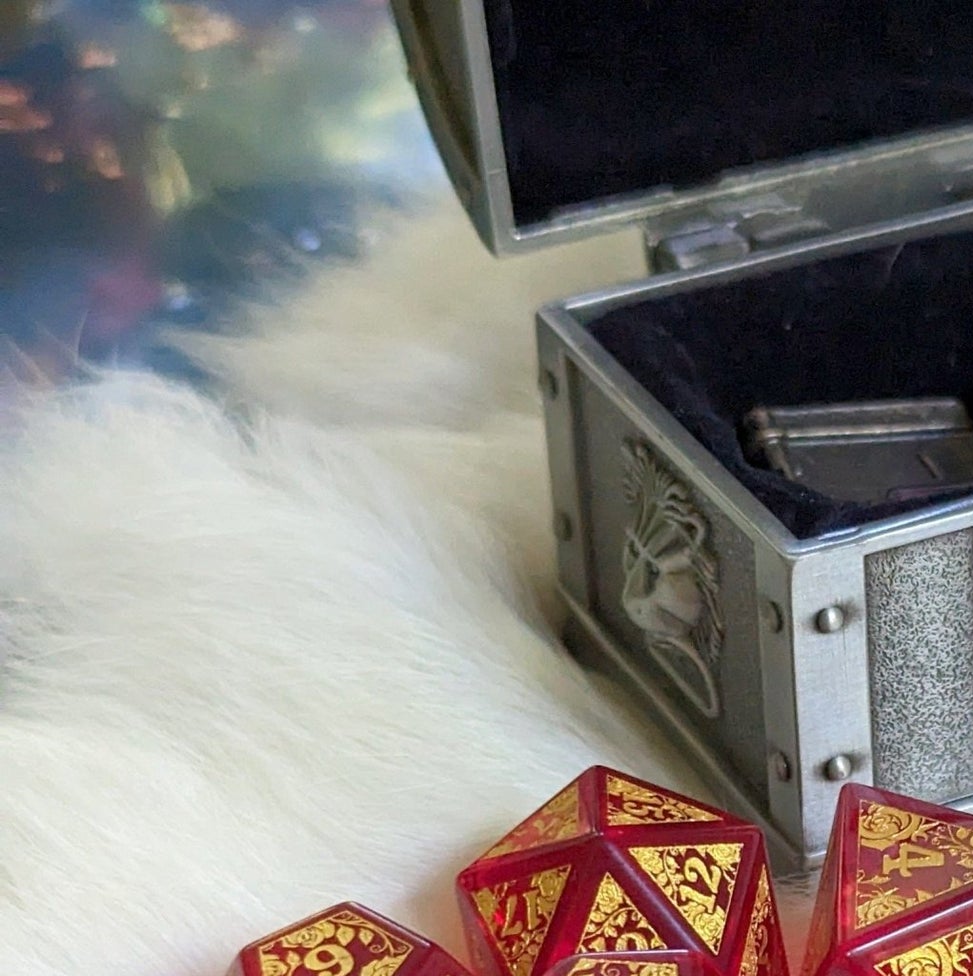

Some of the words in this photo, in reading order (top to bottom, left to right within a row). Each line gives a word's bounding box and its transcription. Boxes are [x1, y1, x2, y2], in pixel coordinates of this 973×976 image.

[883, 842, 945, 877] 4
[679, 856, 722, 914] 12
[502, 889, 541, 937] 17
